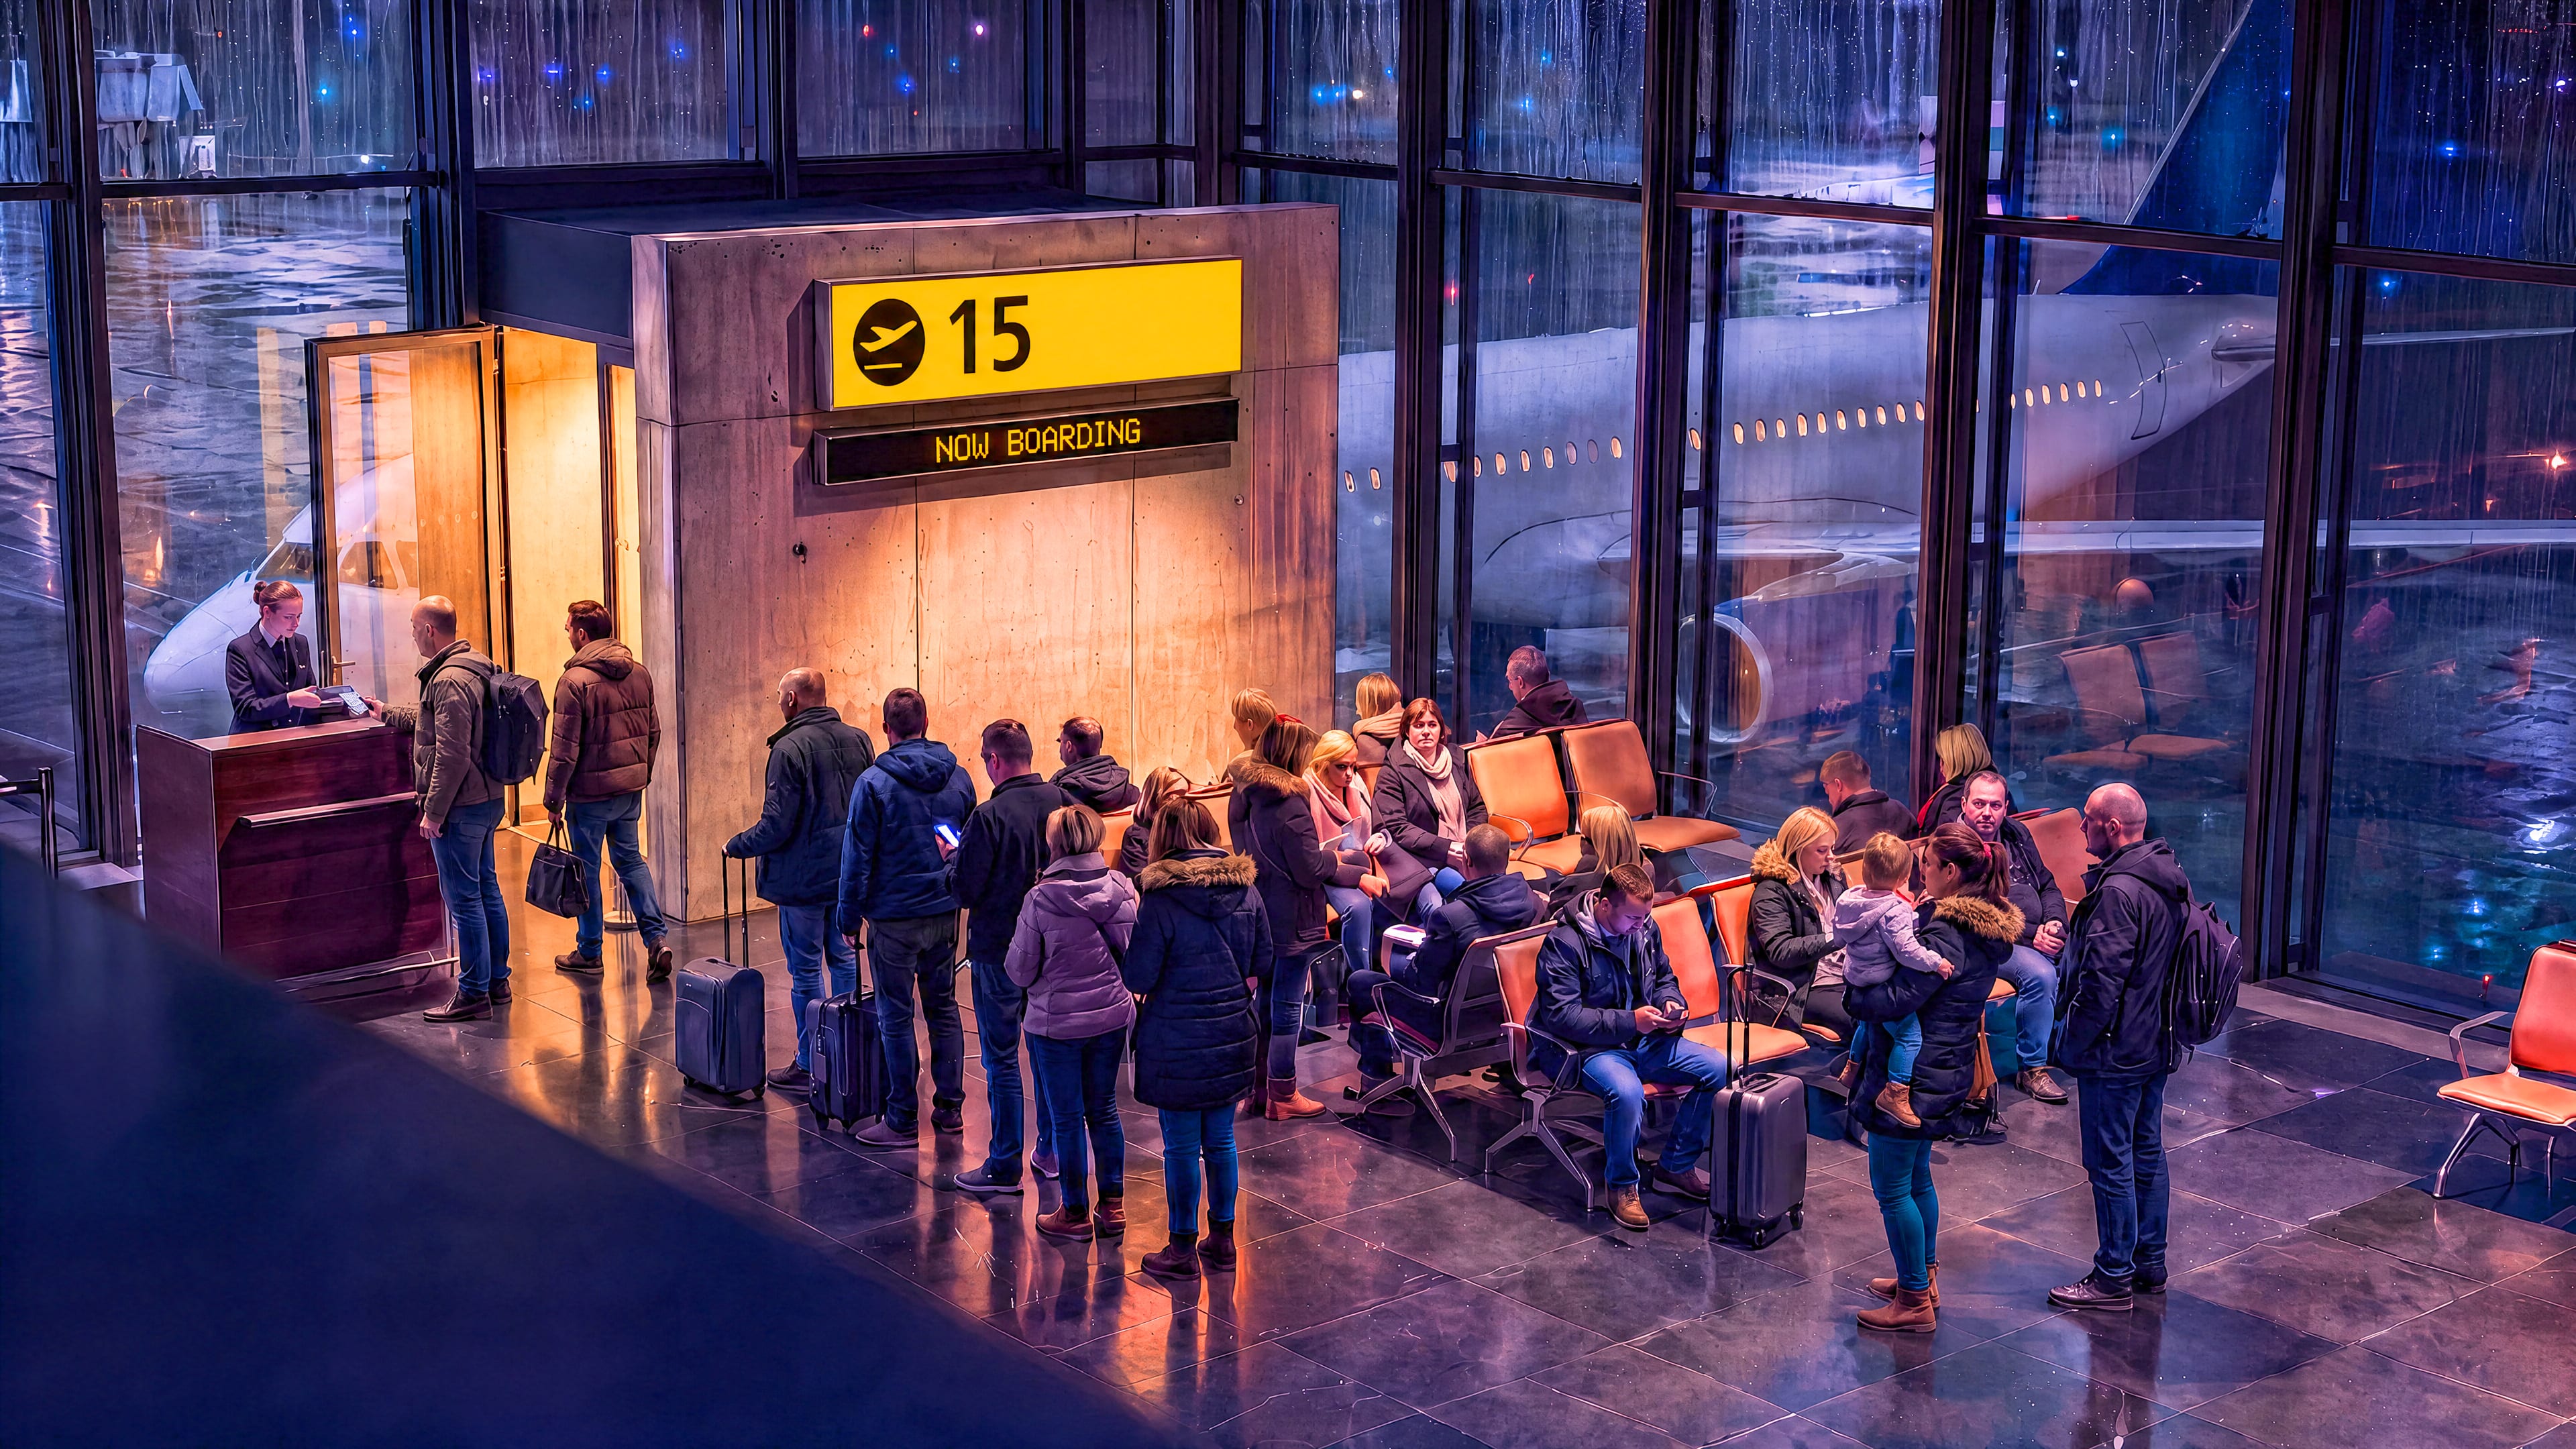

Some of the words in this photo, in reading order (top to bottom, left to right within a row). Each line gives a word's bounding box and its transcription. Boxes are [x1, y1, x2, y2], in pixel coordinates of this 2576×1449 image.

[949, 295, 1030, 374] 15
[935, 431, 989, 464] NOW
[1008, 418, 1140, 456] BOARDING
